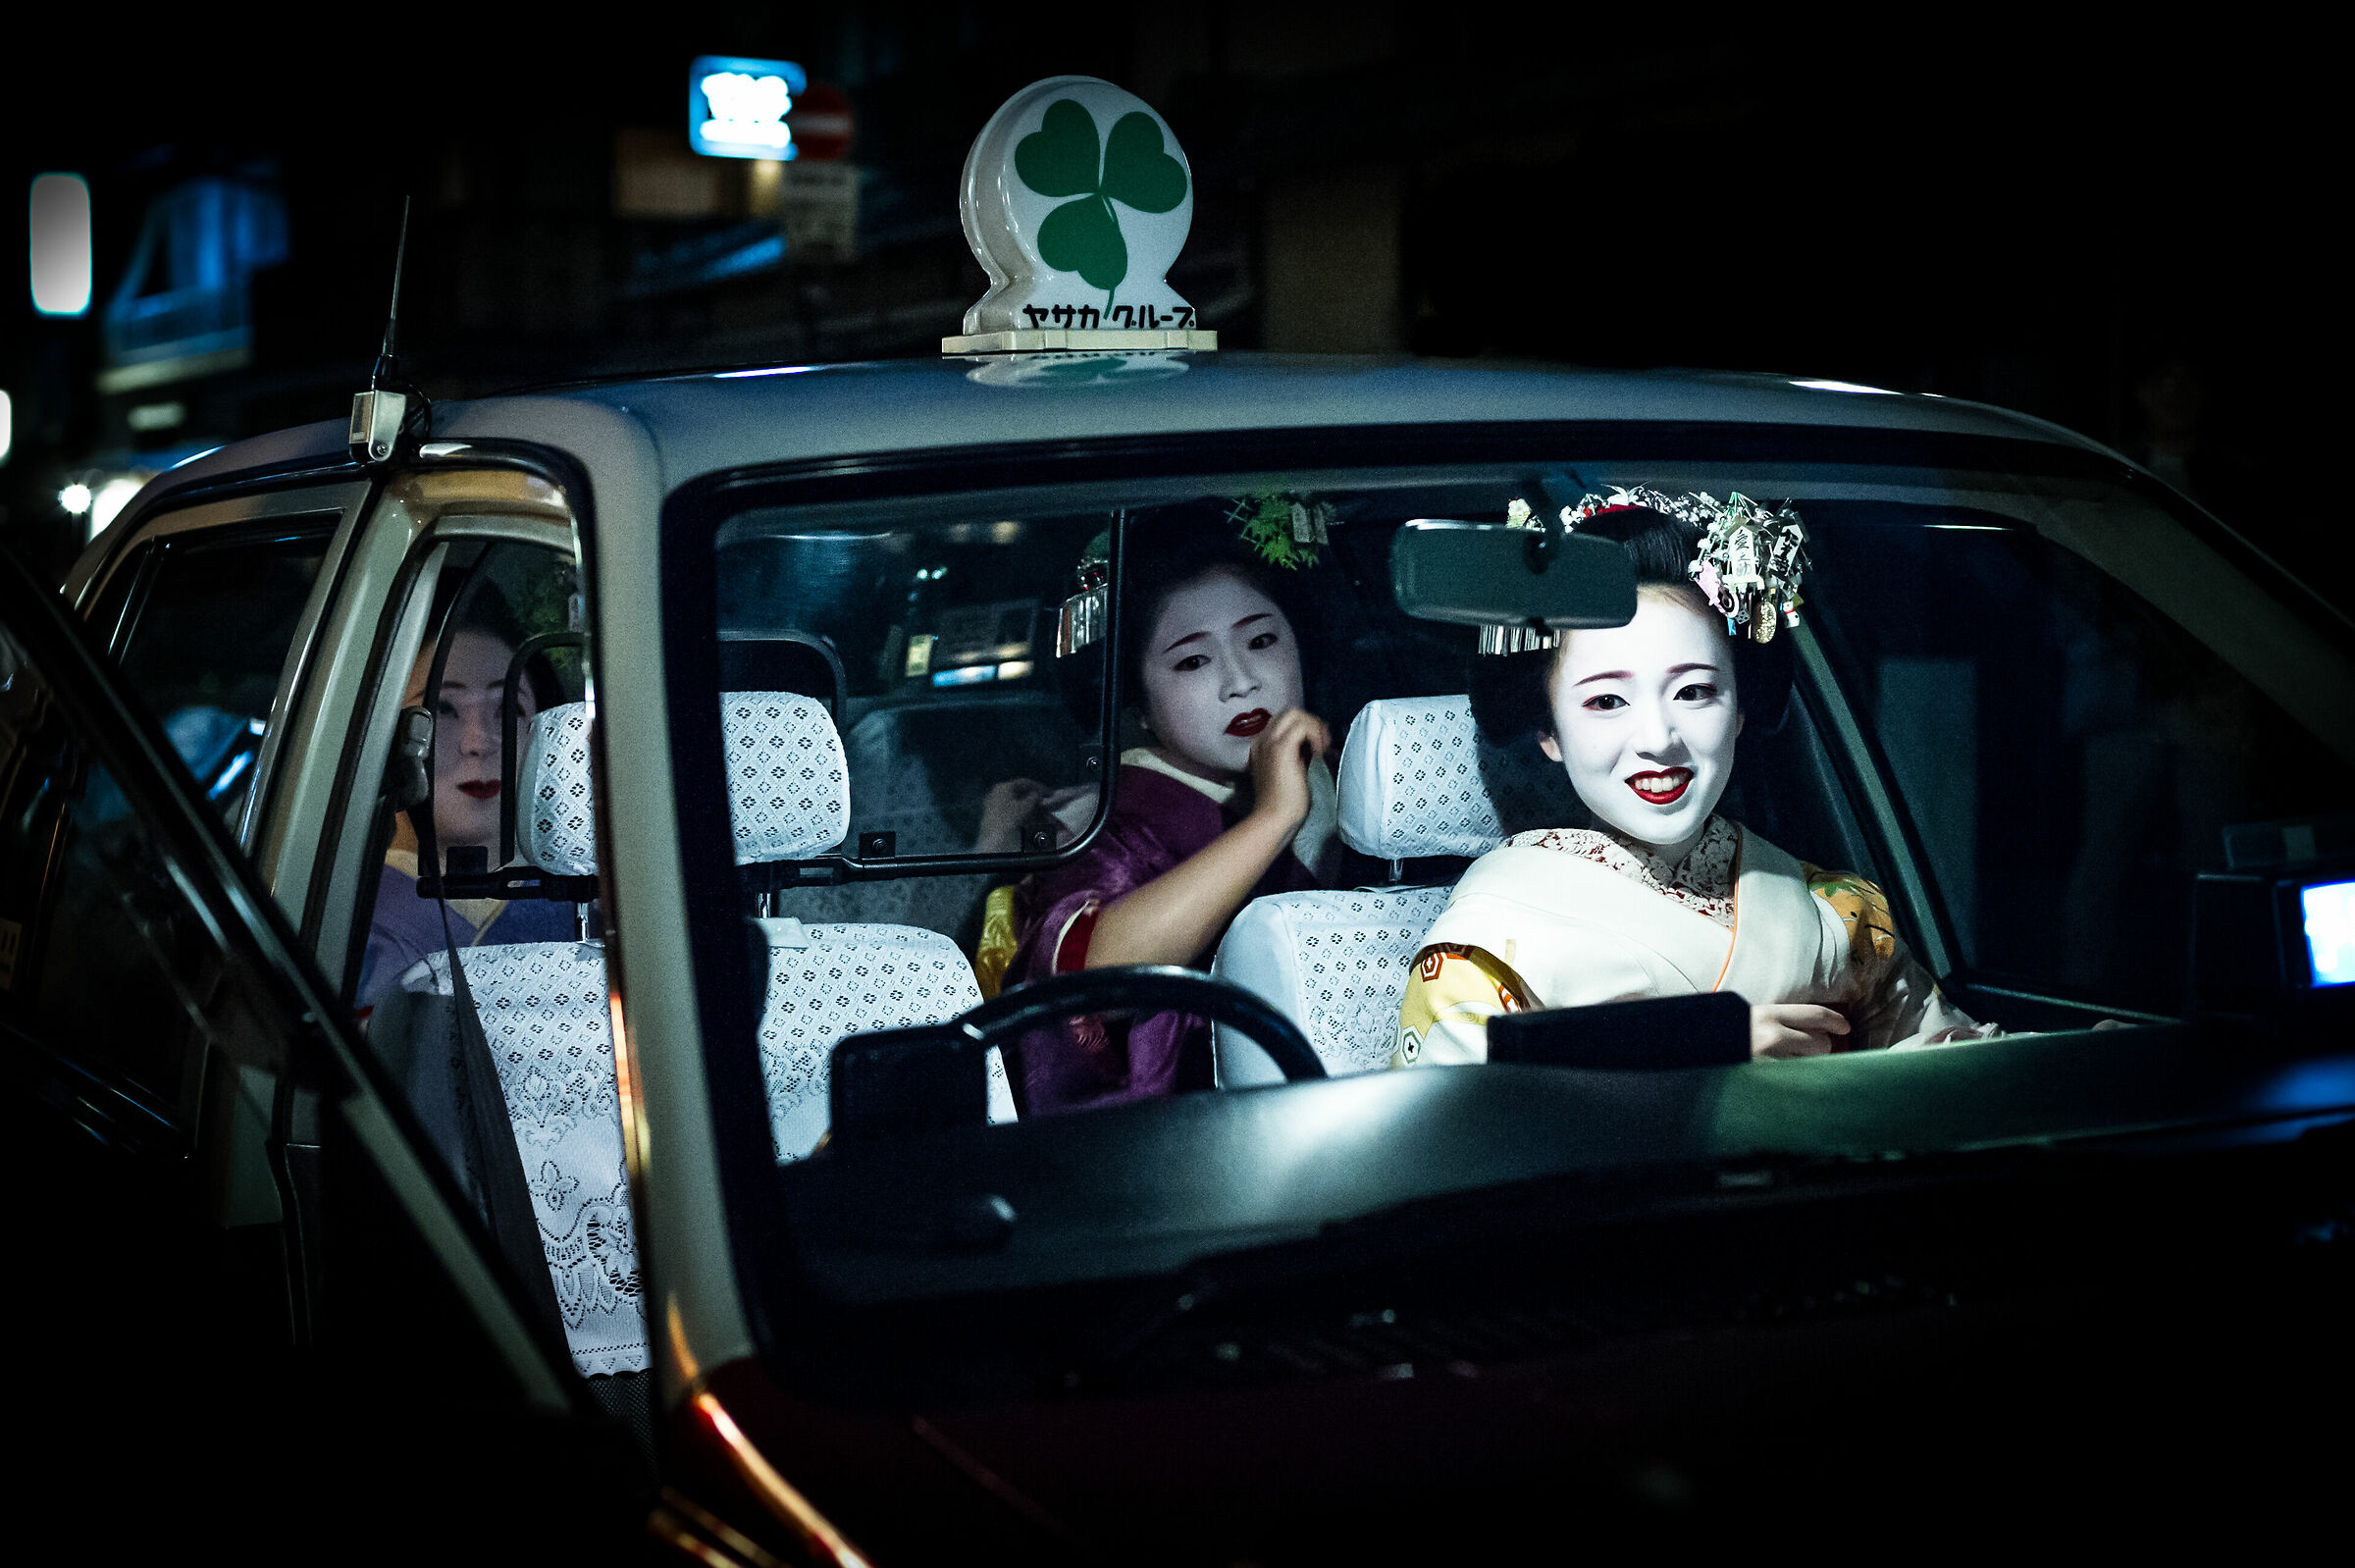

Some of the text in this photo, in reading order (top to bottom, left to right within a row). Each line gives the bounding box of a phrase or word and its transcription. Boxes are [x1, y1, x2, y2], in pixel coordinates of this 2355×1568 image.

[1022, 304, 1195, 329] ヤサカ グループ
